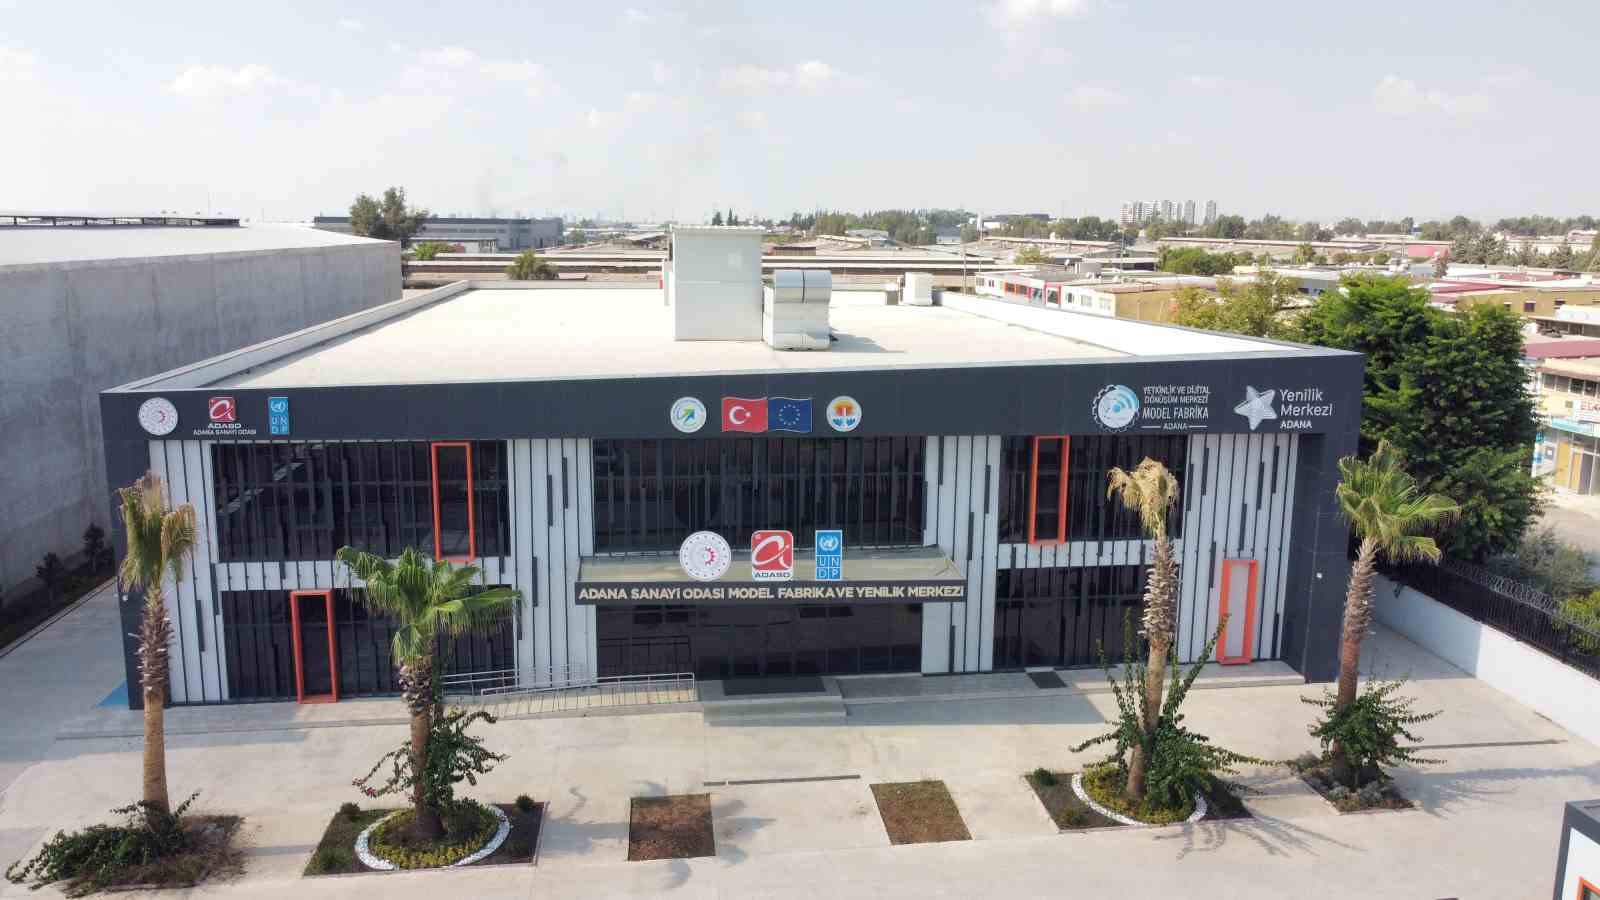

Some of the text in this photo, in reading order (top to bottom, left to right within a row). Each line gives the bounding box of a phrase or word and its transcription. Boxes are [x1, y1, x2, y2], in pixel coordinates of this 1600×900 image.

[1280, 388, 1322, 401] Yenilik
[1142, 407, 1171, 419] MODEL
[1280, 420, 1312, 429] ADANA
[579, 587, 628, 600] ADANA
[728, 586, 774, 599] MODEL
[838, 586, 855, 598] VE
